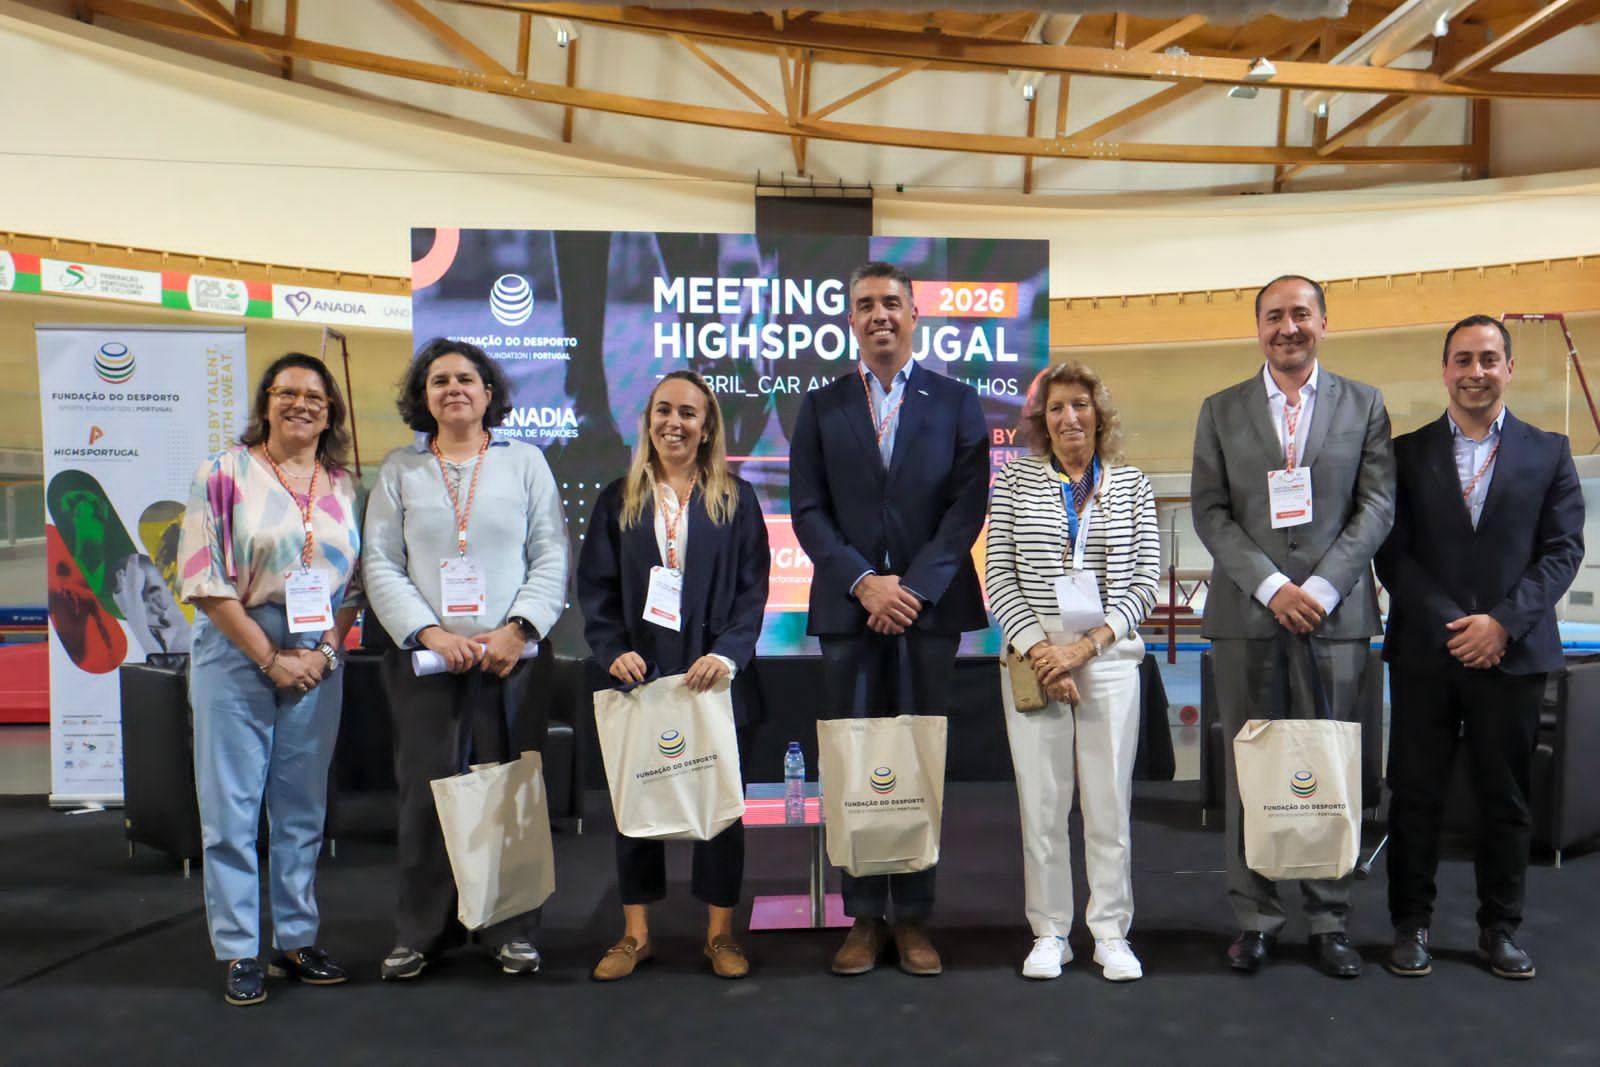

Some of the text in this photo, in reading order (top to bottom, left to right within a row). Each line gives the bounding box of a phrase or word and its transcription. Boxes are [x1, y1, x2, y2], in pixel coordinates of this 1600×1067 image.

[653, 276, 1006, 316] MEETING 2026
[313, 300, 367, 315] ANADIA
[505, 336, 521, 346] DO
[523, 336, 578, 347] DESPORTO
[532, 352, 571, 361] PORTUGAL
[52, 391, 180, 403] FUNDAÇÃO DO DESPORTO
[525, 428, 538, 438] DE
[540, 426, 579, 438] PAIXÕES
[993, 428, 1017, 445] BY
[54, 448, 140, 457] HIGHSPORTUGAL
[635, 765, 672, 779] FUNDAÇÃO
[672, 762, 683, 770] DO
[683, 753, 718, 767] DESPORTO
[844, 799, 879, 808] FUNDAÇÃO
[891, 797, 925, 805] DESPORTO
[1263, 803, 1299, 811] FUNDAÇÃO
